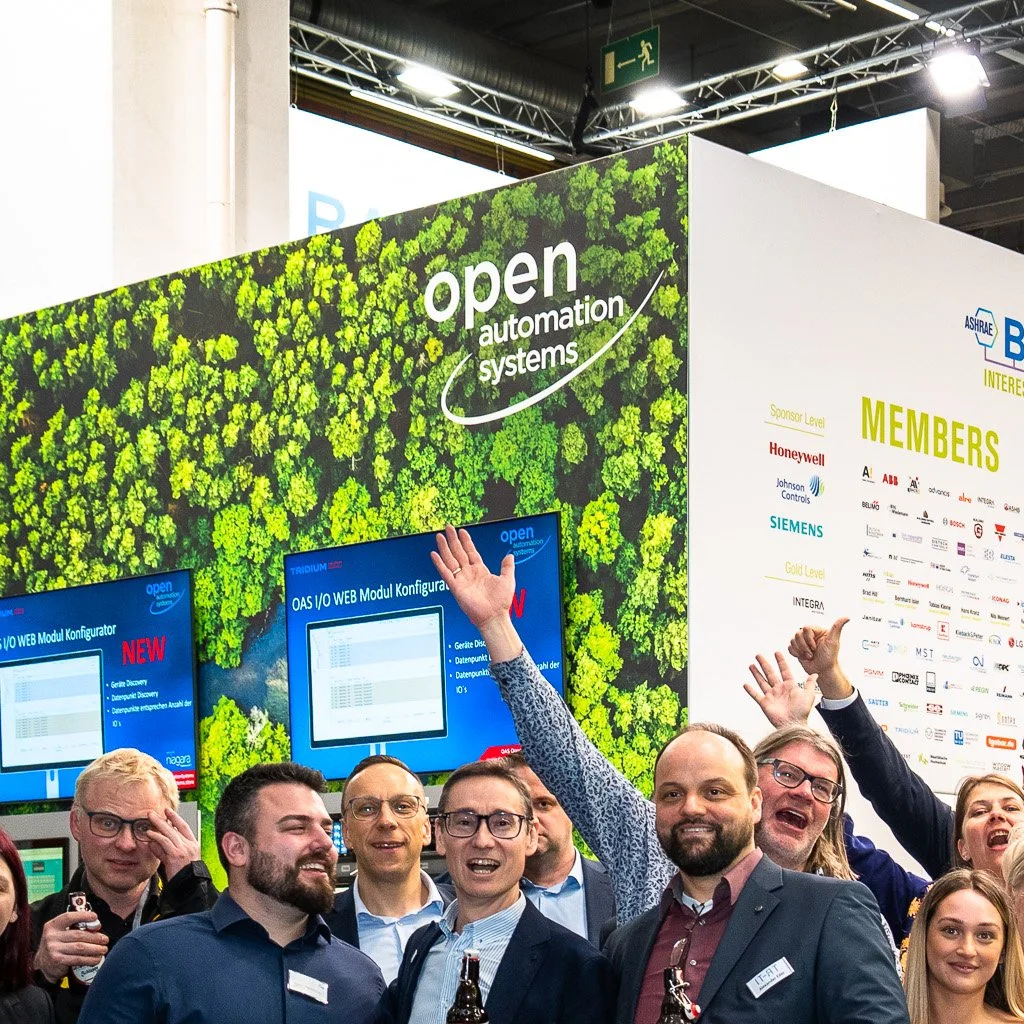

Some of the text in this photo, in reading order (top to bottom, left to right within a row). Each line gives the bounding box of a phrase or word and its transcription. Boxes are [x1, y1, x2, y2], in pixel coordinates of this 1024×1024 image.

[424, 241, 577, 329] open
[478, 295, 624, 347] automation
[964, 315, 994, 337] ASHRAE
[479, 341, 579, 386] systems
[770, 403, 825, 429] Sponsor Level
[862, 396, 999, 473] MEMBERS
[769, 441, 825, 467] Honeywell
[776, 478, 805, 492] Johnson
[882, 473, 899, 486] ABB
[781, 490, 811, 505] Controls
[861, 501, 880, 511] BELIMO
[770, 515, 824, 538] SIEMENS
[949, 519, 966, 529] BOSCH
[500, 526, 534, 545] open
[512, 538, 544, 549] automation
[290, 562, 327, 576] TRIDIUM
[785, 561, 825, 580] Gold Level
[146, 580, 173, 597] open
[292, 579, 450, 612] OAS I/O WEB Modul Konfigurat
[792, 596, 825, 611] INTEGRA
[3, 624, 117, 652] I/O WEB Modul Konfigurator
[454, 640, 474, 650] Geräte
[122, 635, 167, 666] NEW
[915, 647, 934, 659] MST
[455, 655, 488, 665] Datenpunkt
[537, 661, 549, 671] zahl
[549, 660, 560, 670] der
[126, 679, 148, 687] Discovery
[898, 678, 919, 686] CONTACT
[137, 691, 159, 699] Discovery
[868, 698, 889, 707] SAUTER
